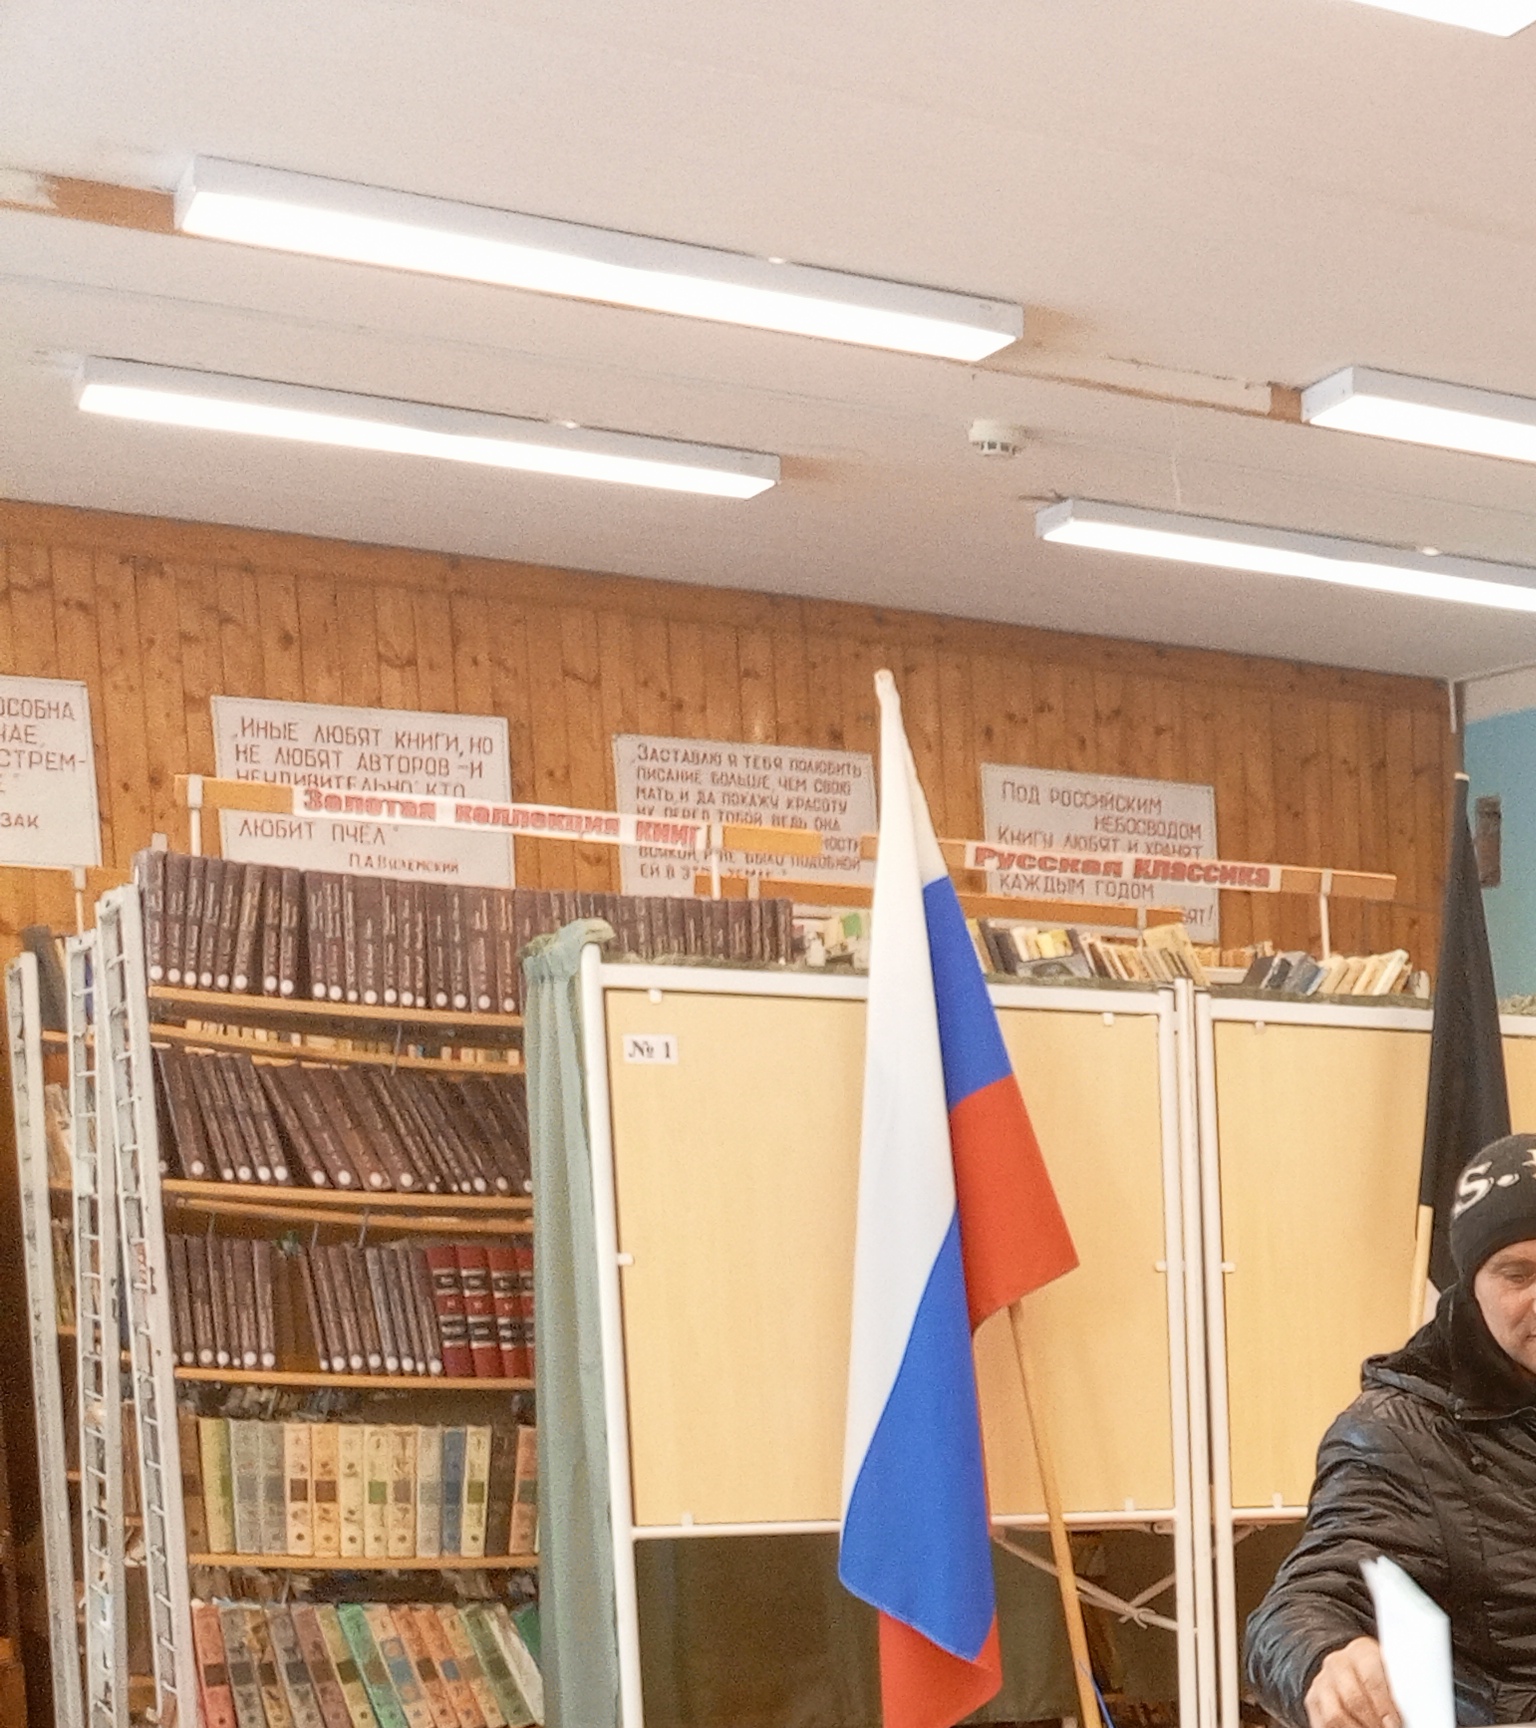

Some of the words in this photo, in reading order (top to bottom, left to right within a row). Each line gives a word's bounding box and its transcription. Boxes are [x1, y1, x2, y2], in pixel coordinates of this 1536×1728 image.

[314, 723, 382, 747] ЛЮБЯТ
[469, 736, 493, 755] НО
[235, 743, 261, 764] НЕ
[274, 748, 343, 769] ЛЮБЯТ
[357, 752, 450, 777] АВТОРОВ
[728, 755, 738, 768] Я
[742, 754, 783, 771] ТЕБЯ
[788, 758, 862, 778] ПОЛЮБИТЬ
[637, 766, 702, 785] ПИСАНИЕ
[778, 776, 807, 793] ЧЕМ
[813, 778, 851, 796] СВОЮ
[304, 788, 437, 822] Золотая
[454, 802, 622, 838] коллекция
[721, 791, 781, 808] ПОКАЖУ
[785, 795, 848, 814] КРАСОТУ
[1050, 788, 1162, 814] РОССИЙСКИМ
[238, 818, 314, 840] ЛЮБИТ
[1094, 815, 1202, 841] НЕБОСВОДОМ
[1062, 831, 1120, 852] ЛЮБЯТ
[975, 845, 1124, 878] Русская
[999, 874, 1085, 896] КАЖДЫМ
[1094, 879, 1155, 900] ГОДОМ
[664, 1041, 671, 1059] 1
